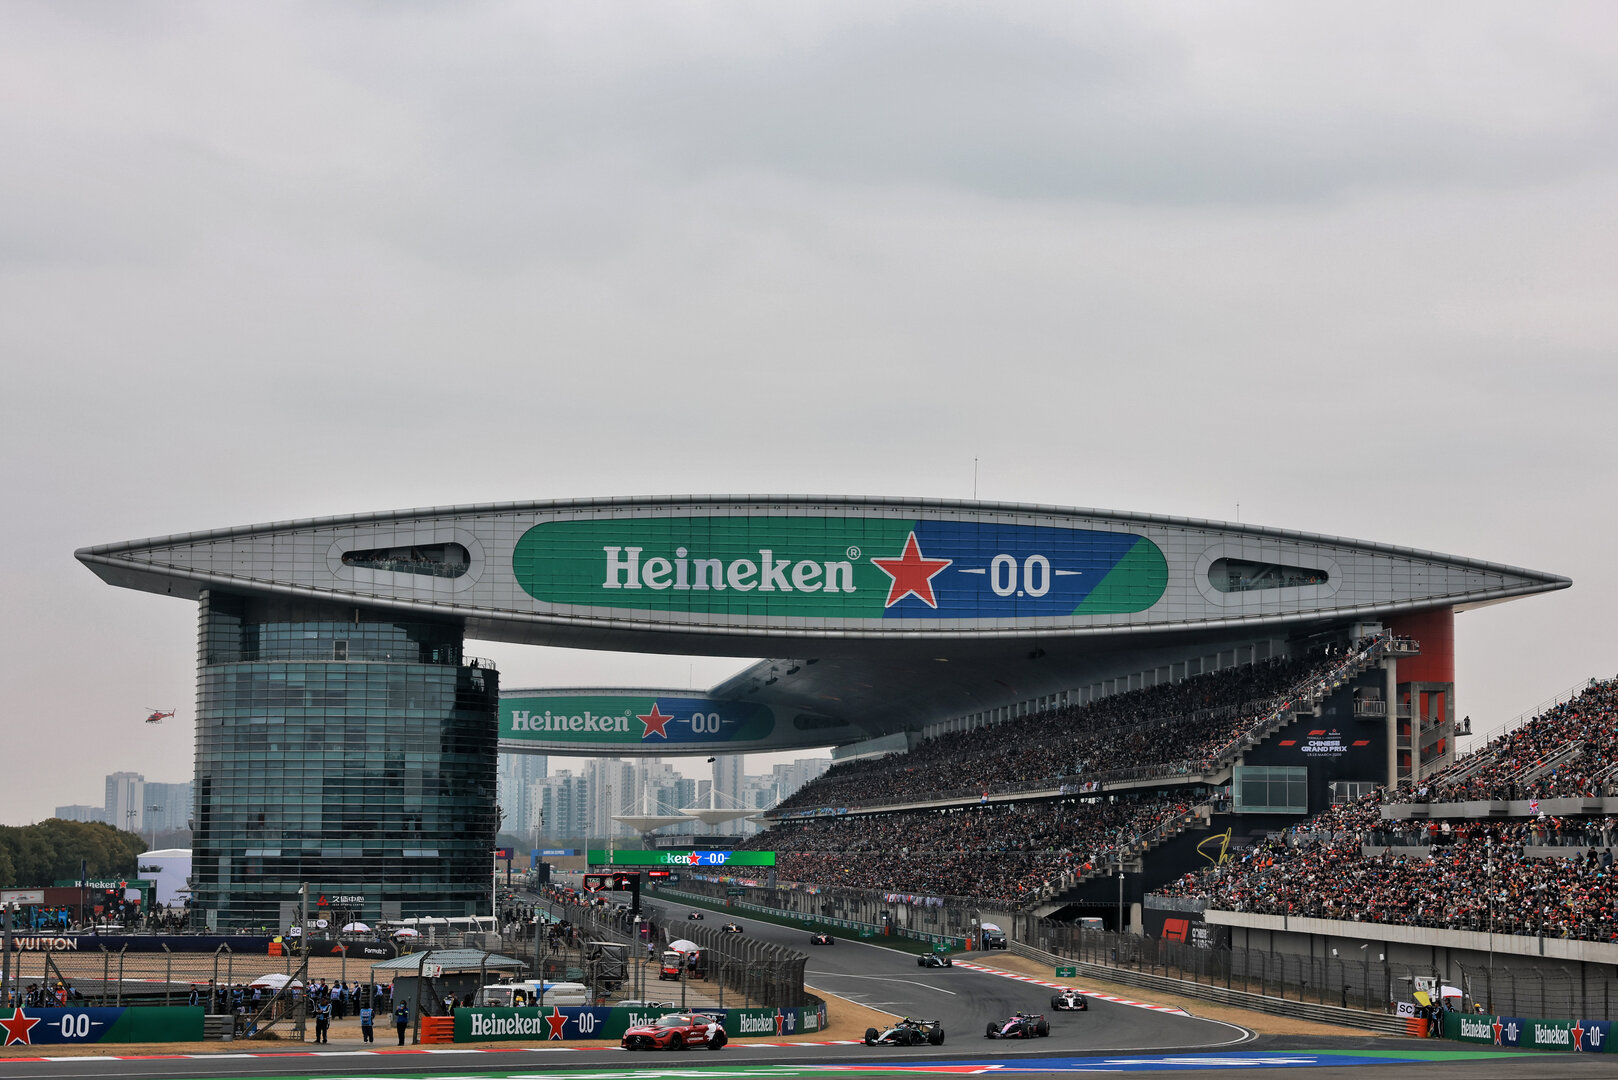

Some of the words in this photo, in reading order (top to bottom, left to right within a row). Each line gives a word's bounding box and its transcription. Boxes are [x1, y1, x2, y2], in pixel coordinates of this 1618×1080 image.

[709, 853, 725, 864] 0.0
[14, 937, 78, 951] VUITTON
[1399, 1004, 1413, 1014] SC
[61, 1013, 90, 1037] 0.0
[578, 1012, 594, 1034] 0.0
